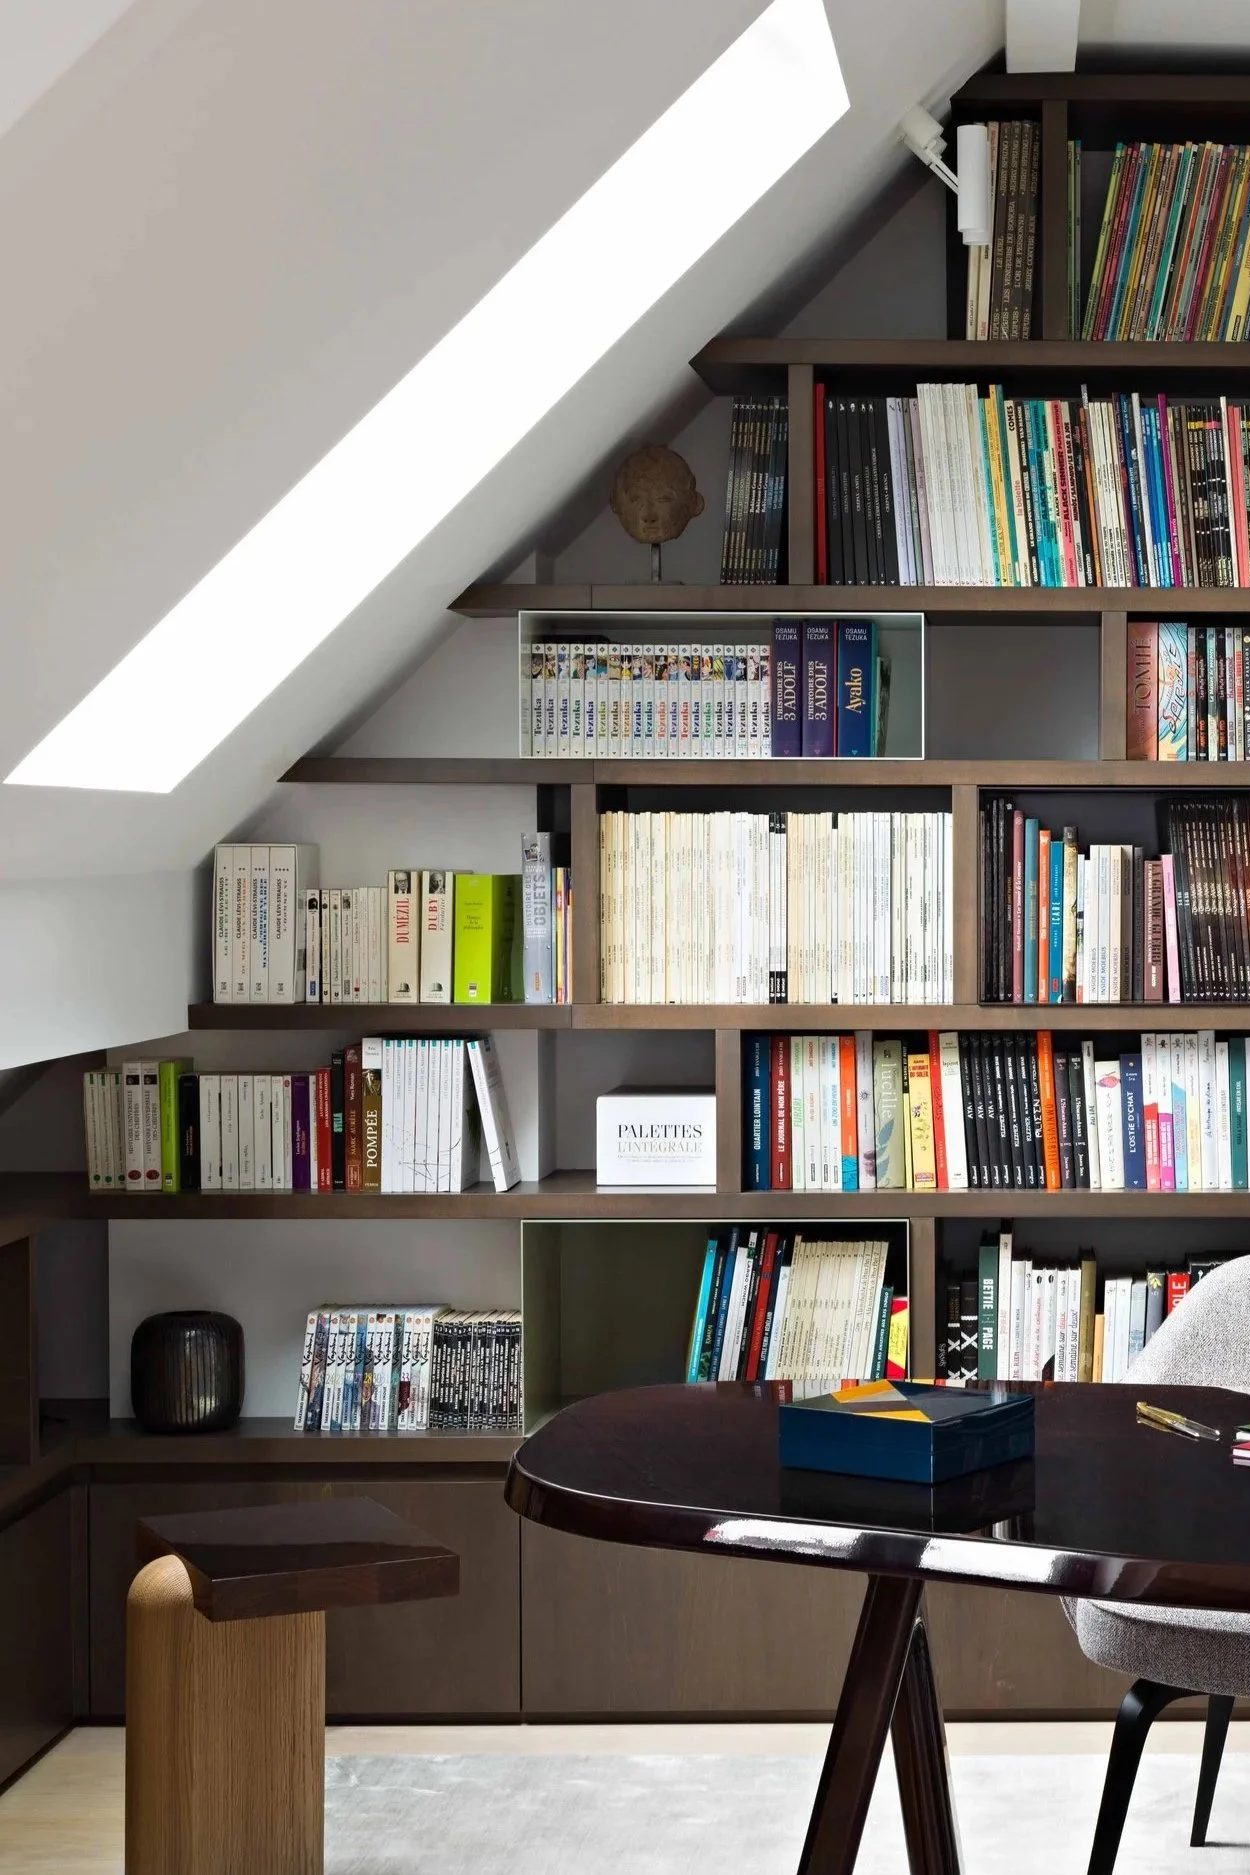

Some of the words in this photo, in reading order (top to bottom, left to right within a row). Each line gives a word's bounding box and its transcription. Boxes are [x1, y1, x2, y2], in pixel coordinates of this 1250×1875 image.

[1058, 451, 1067, 487] SINNER
[1061, 488, 1070, 520] ALACK
[783, 661, 797, 711] ADOLF
[845, 667, 866, 714] Ayako
[586, 700, 594, 739] Tezuka
[645, 700, 653, 739] Tezuka
[681, 700, 689, 739] Tezuka
[428, 898, 438, 931] DUBY
[533, 875, 547, 926] OBJETS
[1052, 902, 1060, 926] ICARE
[393, 898, 410, 943] DUMÉZIL
[753, 1089, 761, 1118] LOINTAIN
[777, 1096, 785, 1109] MON
[363, 1109, 378, 1168] POMPÉE
[618, 1124, 702, 1138] PALETTES
[753, 1119, 761, 1150] QUARTIER
[777, 1118, 785, 1144] JOURNAL
[982, 1279, 993, 1310] BETTIE
[982, 1327, 993, 1350] PAGE
[1070, 1343, 1078, 1373] semaine
